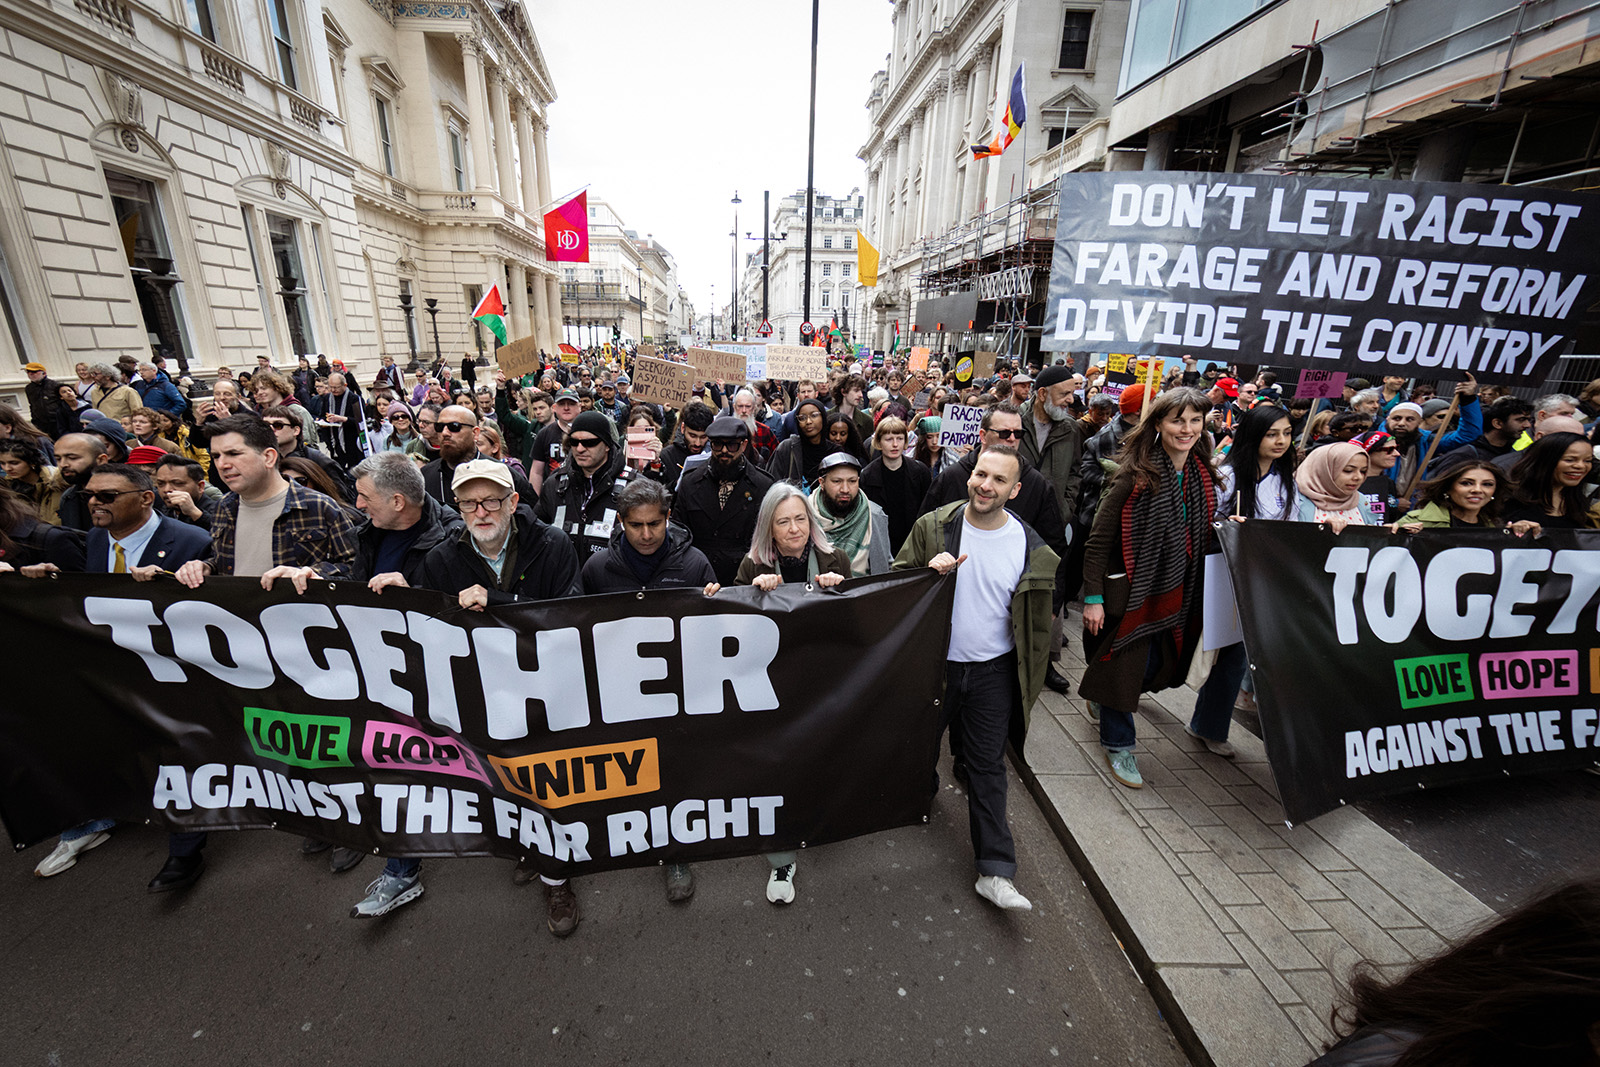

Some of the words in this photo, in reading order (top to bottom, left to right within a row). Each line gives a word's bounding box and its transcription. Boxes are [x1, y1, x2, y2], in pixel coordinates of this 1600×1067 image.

[1108, 182, 1256, 230] DON'T
[1267, 187, 1369, 237] LET
[1377, 193, 1582, 252] RACIST
[1074, 242, 1269, 293] FARAGE
[1276, 251, 1381, 302] AND
[1388, 259, 1587, 320] REFORM
[638, 360, 677, 378] SEEKING
[1054, 298, 1247, 350] DIVIDE
[1261, 309, 1352, 360] THE
[1357, 318, 1564, 376] COUNTRY
[633, 382, 651, 395] NOT
[651, 387, 658, 398] A
[660, 388, 688, 402] CRIME
[637, 372, 674, 388] ASYLUM
[677, 380, 688, 391] IS
[804, 371, 825, 379] JETS
[951, 405, 983, 422] RACIS
[84, 596, 780, 740] TOGETHER
[1401, 660, 1466, 700] LOVE
[1485, 658, 1571, 691] HOPE
[252, 717, 340, 761] LOVE
[373, 731, 482, 777] HOPE
[500, 749, 646, 800] UNITY
[1345, 716, 1483, 779] AGAINST
[1489, 710, 1565, 755] THE
[153, 763, 364, 825] AGAINST
[373, 783, 483, 834] THE
[492, 797, 592, 862] FAR
[606, 795, 784, 857] RIGHT
